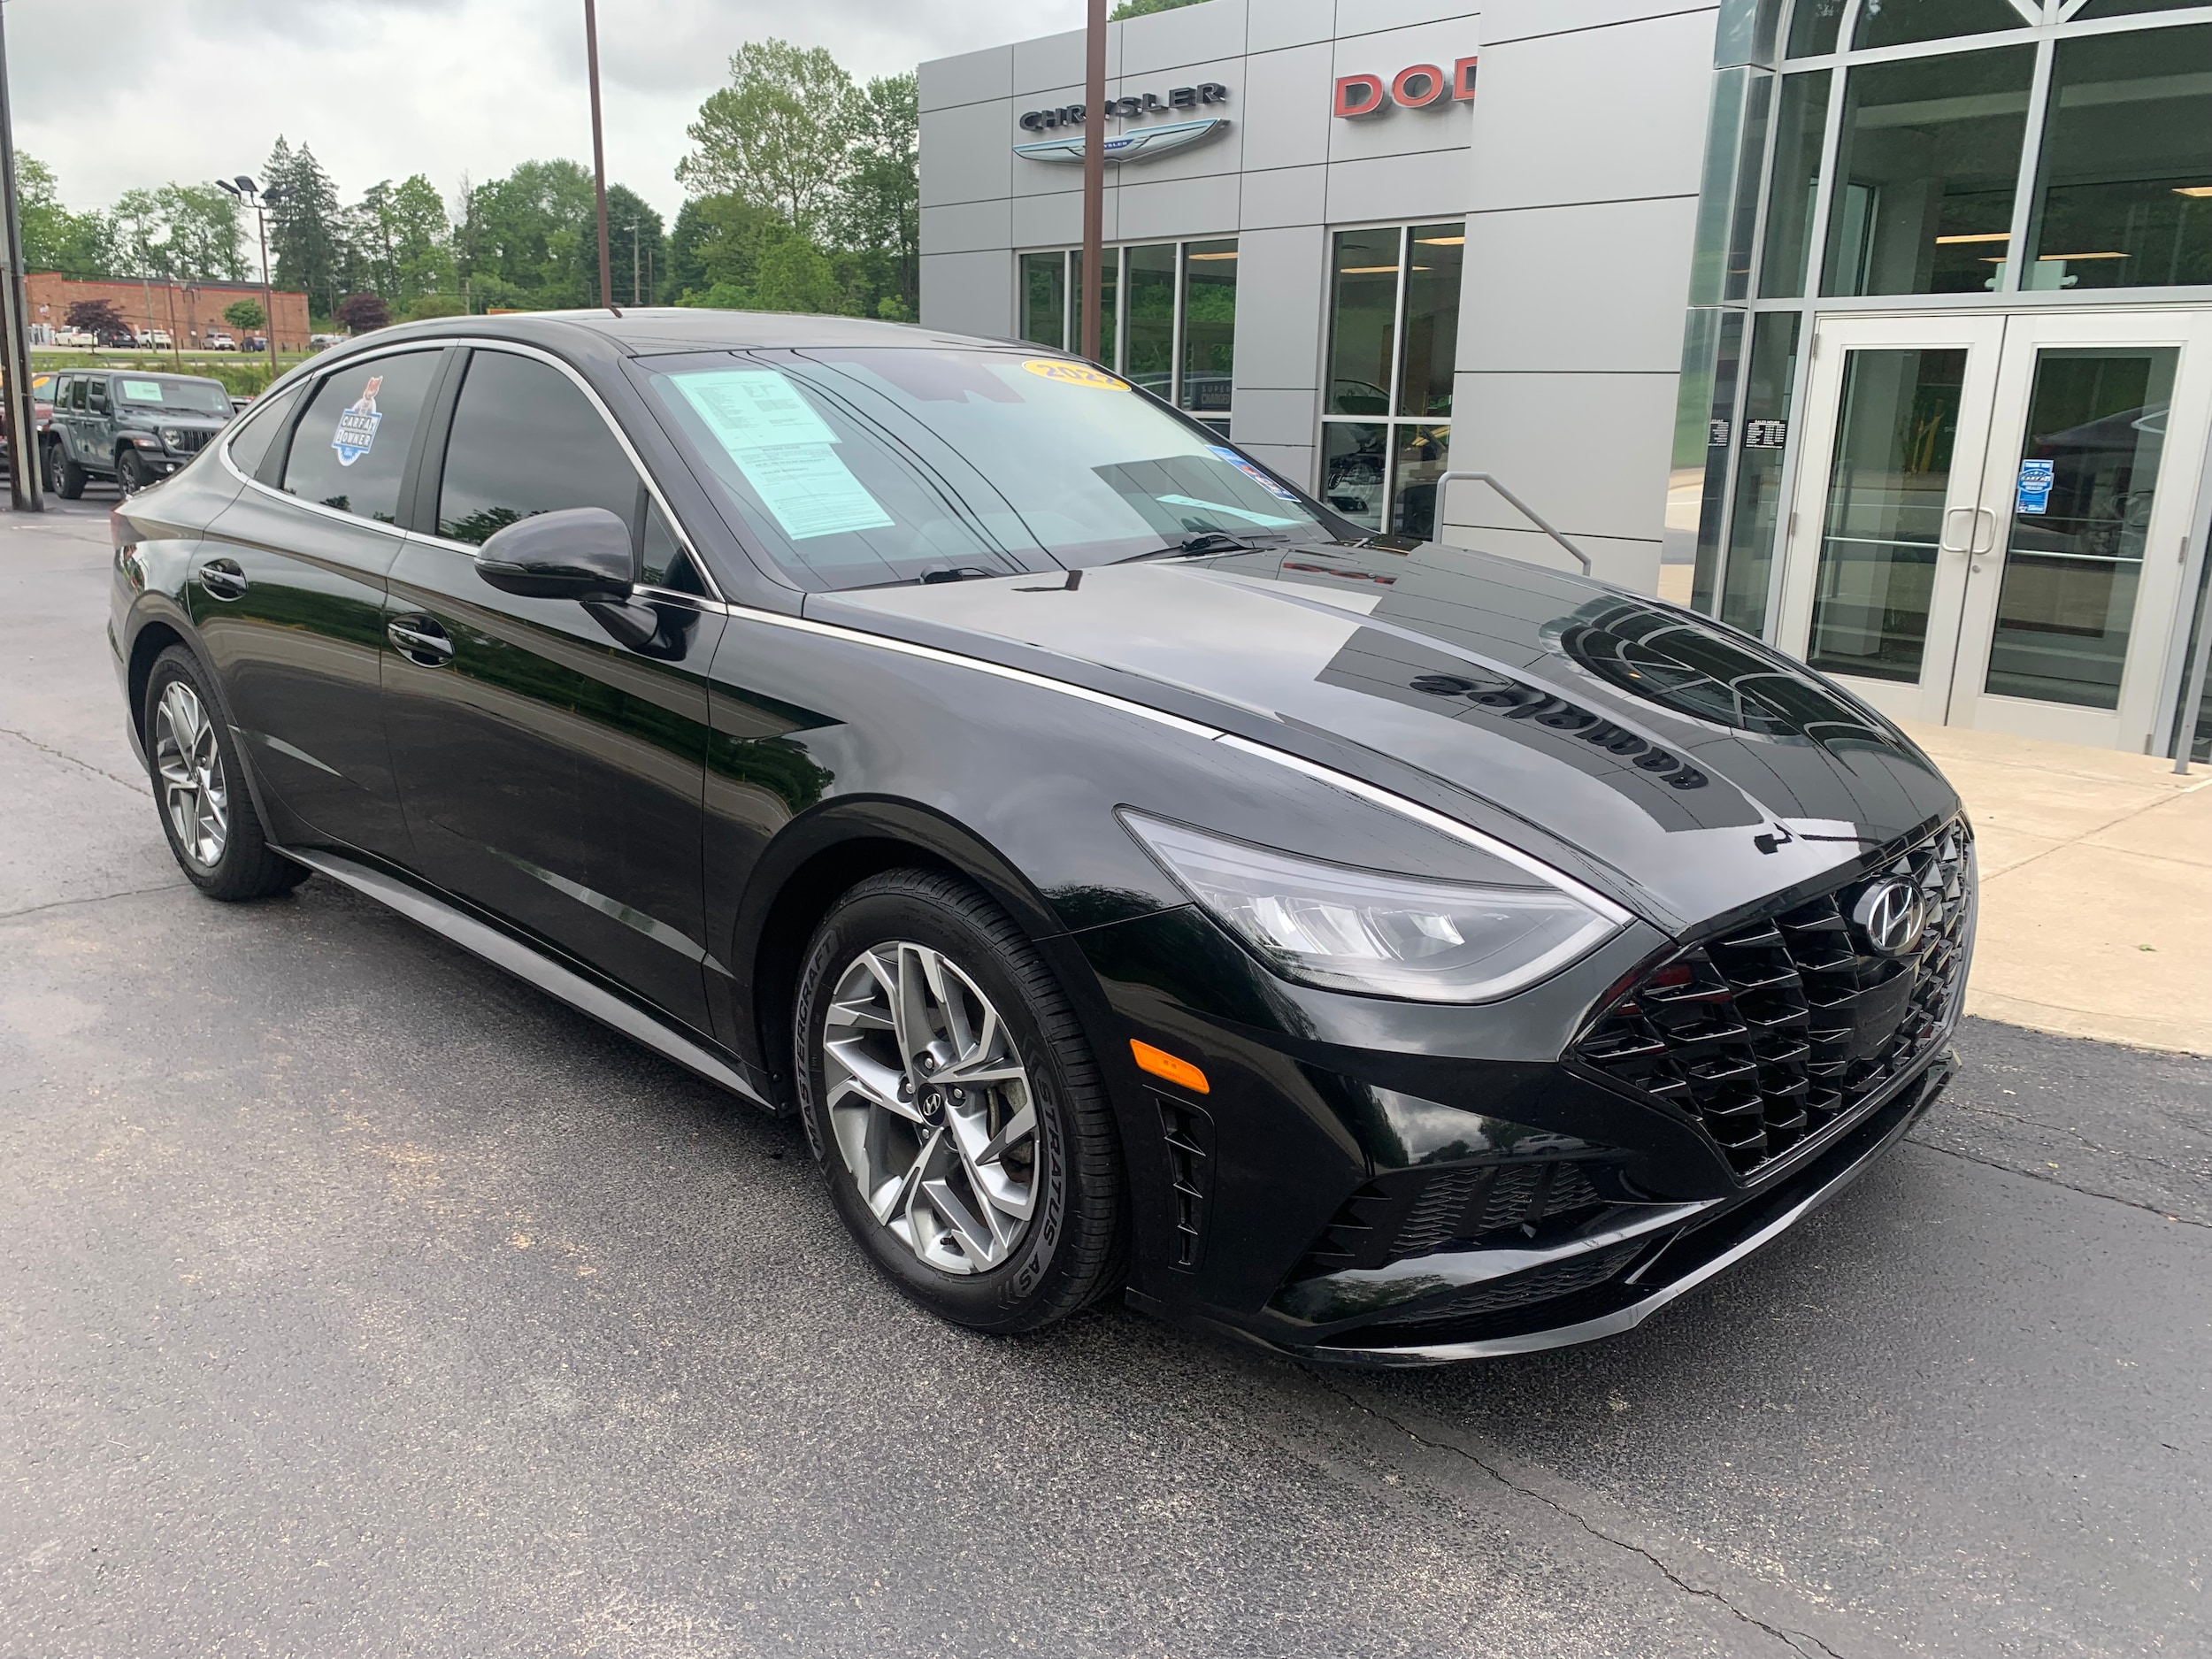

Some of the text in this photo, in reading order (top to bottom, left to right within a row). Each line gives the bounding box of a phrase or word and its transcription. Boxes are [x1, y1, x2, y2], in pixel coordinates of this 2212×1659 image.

[1019, 82, 1228, 132] CHRSLER
[342, 431, 371, 447] OWNER
[797, 932, 834, 1152] MASTERCRAFT
[1018, 1078, 1062, 1293] STRATUS AS
